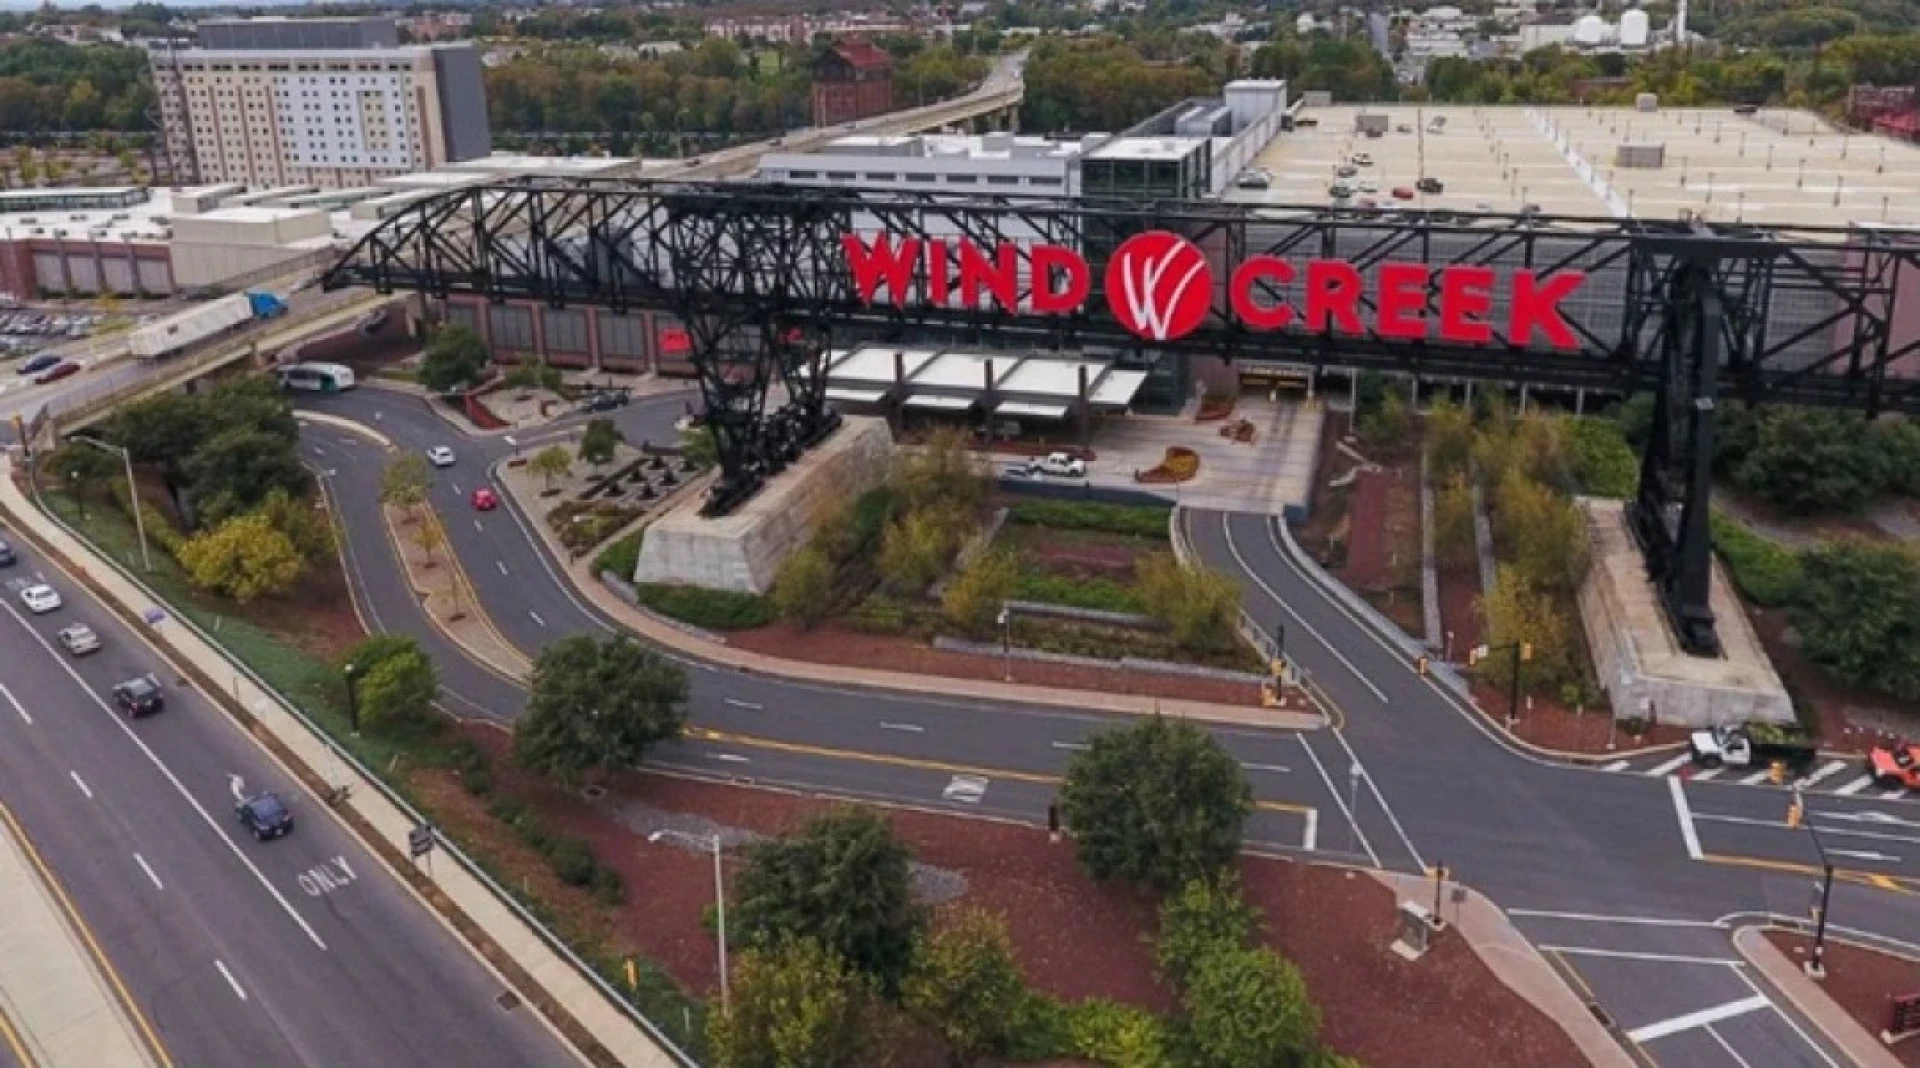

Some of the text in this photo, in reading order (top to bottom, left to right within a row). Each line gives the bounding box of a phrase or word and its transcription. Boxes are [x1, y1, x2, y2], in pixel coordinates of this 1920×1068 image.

[840, 230, 1090, 316] WIND
[1230, 253, 1586, 352] CREEK
[298, 855, 357, 896] ONLY
